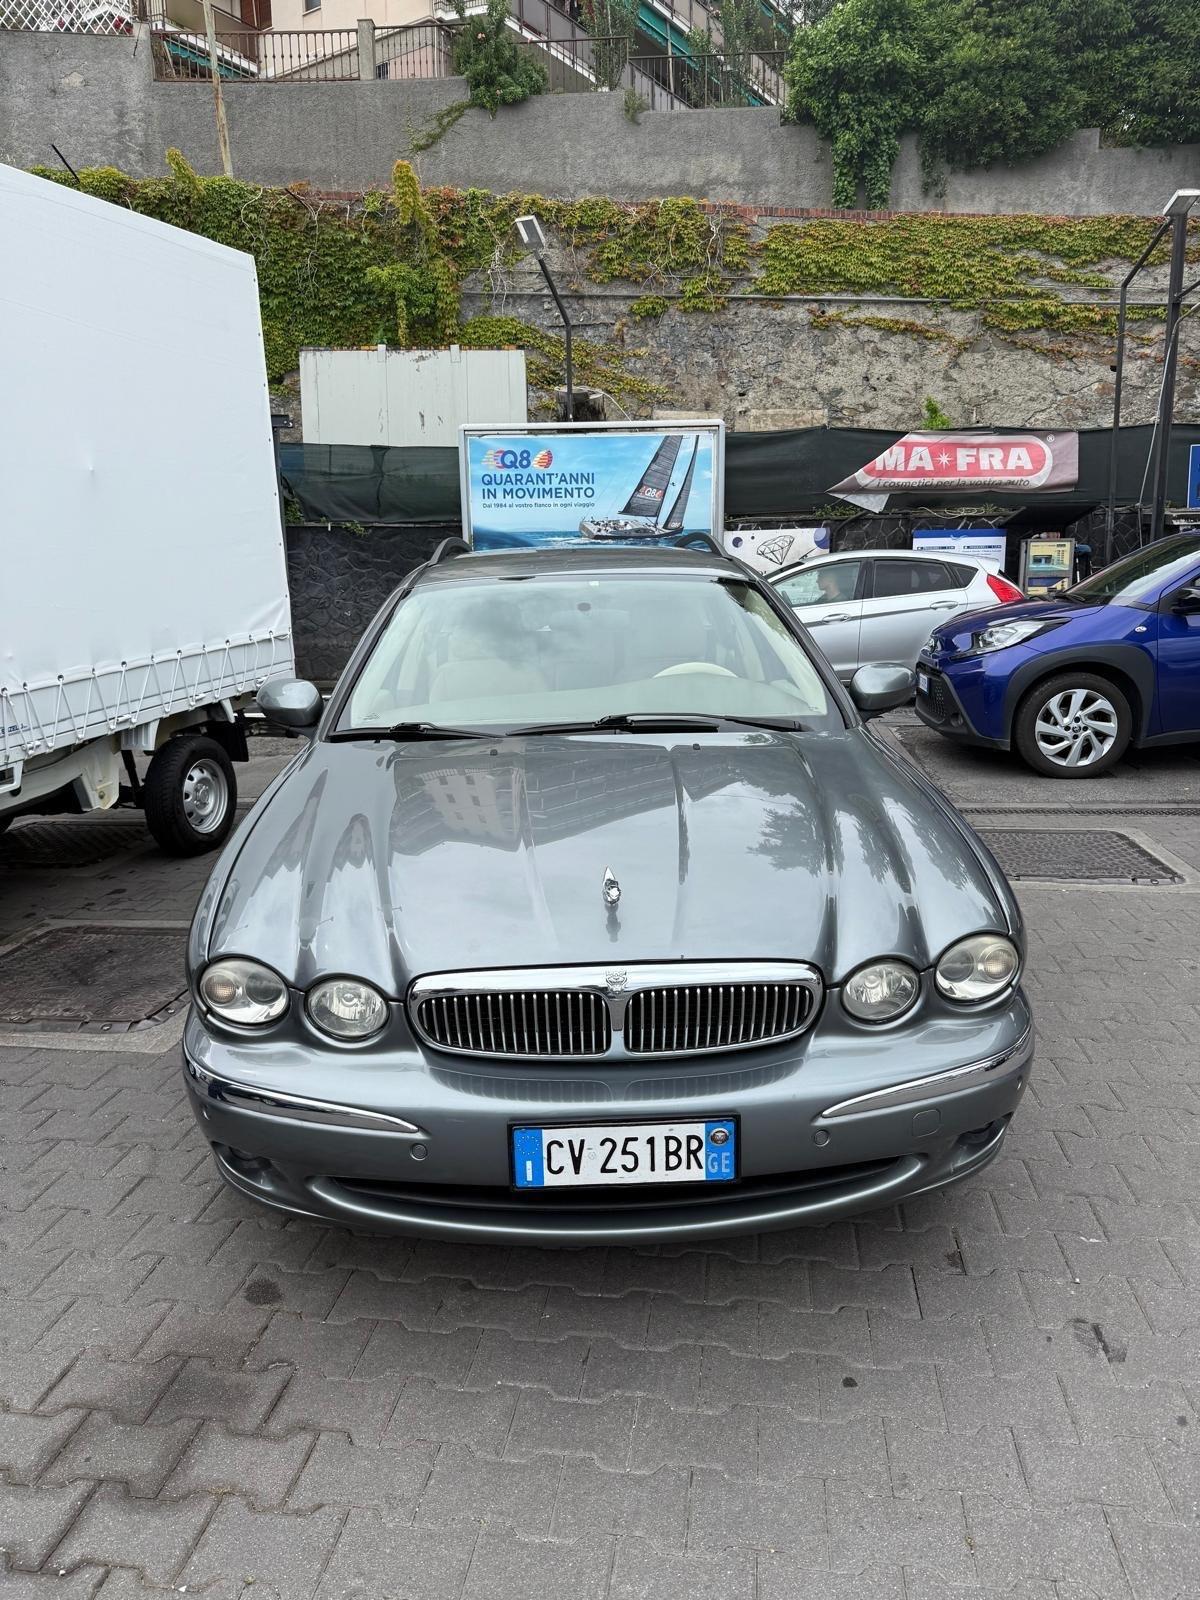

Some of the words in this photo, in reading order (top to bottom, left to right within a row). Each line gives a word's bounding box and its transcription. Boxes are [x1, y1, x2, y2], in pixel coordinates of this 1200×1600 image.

[500, 449, 531, 470] Q8
[875, 446, 935, 471] MA
[957, 447, 1033, 471] FRA
[481, 472, 595, 486] QUARANT'ANNI
[883, 478, 934, 488] cosmetici
[936, 479, 956, 490] per
[1005, 477, 1030, 487] auto
[482, 487, 497, 500] IN
[503, 486, 595, 499] MOVIMENTO
[560, 501, 573, 509] ogni
[546, 1138, 586, 1176] CV
[599, 1134, 704, 1174] 251BR
[707, 1152, 730, 1174] GE
